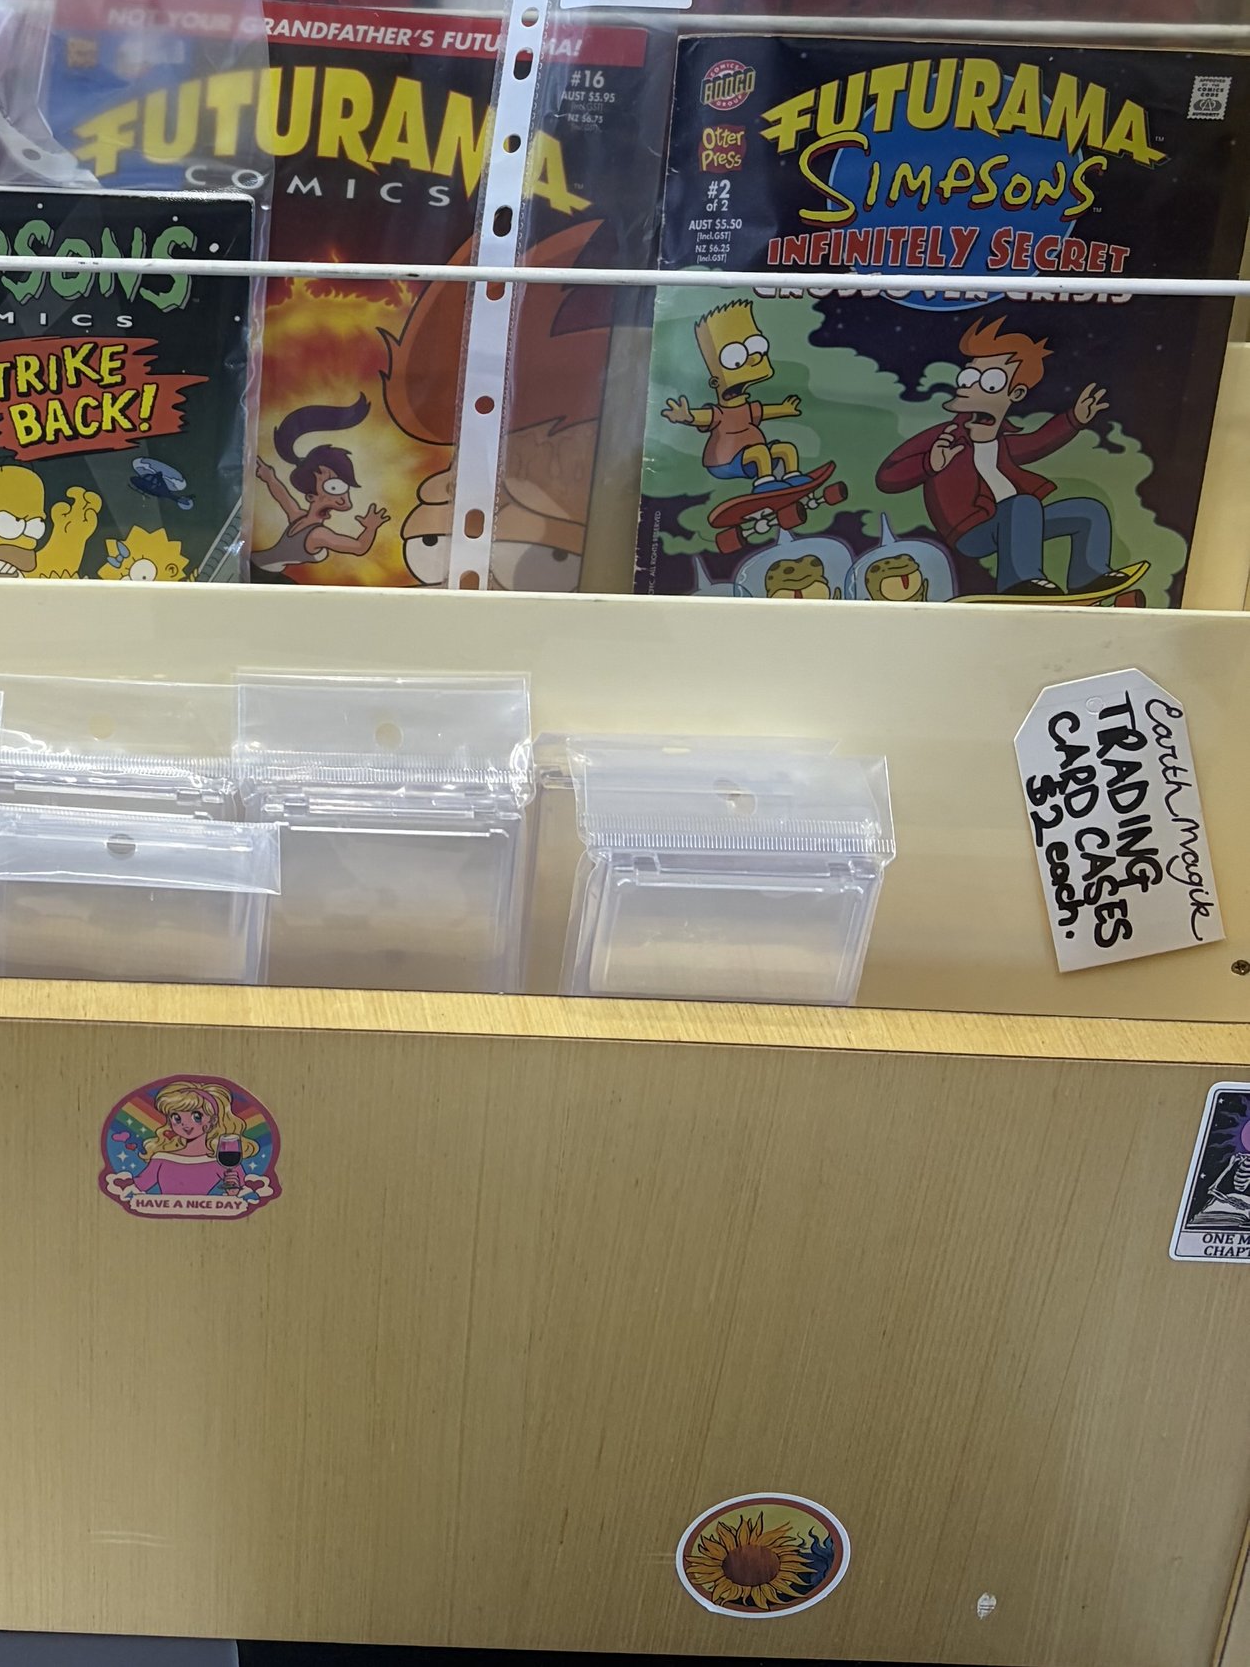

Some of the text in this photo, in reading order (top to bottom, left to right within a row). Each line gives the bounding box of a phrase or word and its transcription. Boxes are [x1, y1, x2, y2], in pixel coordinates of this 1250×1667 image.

[239, 16, 436, 49] GRANDFATHER'S
[570, 70, 605, 89] #16
[702, 70, 756, 105] BONGO
[588, 92, 616, 103] $5.95
[760, 58, 1168, 167] FUTURAMA
[702, 127, 745, 150] Otter
[702, 149, 742, 172] Press
[184, 164, 451, 208] COMICS
[707, 179, 730, 199] #2
[798, 131, 1107, 224] SIMPSONS
[706, 199, 729, 212] of 2
[688, 218, 743, 230] AUST $5.50
[695, 244, 730, 253] NZ $6.25
[767, 226, 1131, 273] INFINITELY SECRET
[9, 384, 159, 448] BACK!
[1096, 690, 1164, 893] TRADING
[1026, 774, 1064, 847] $2
[1048, 710, 1133, 948] CARD CASES
[136, 1199, 242, 1211] HAVE A NICE DAY
[1202, 1233, 1234, 1244] ONE
